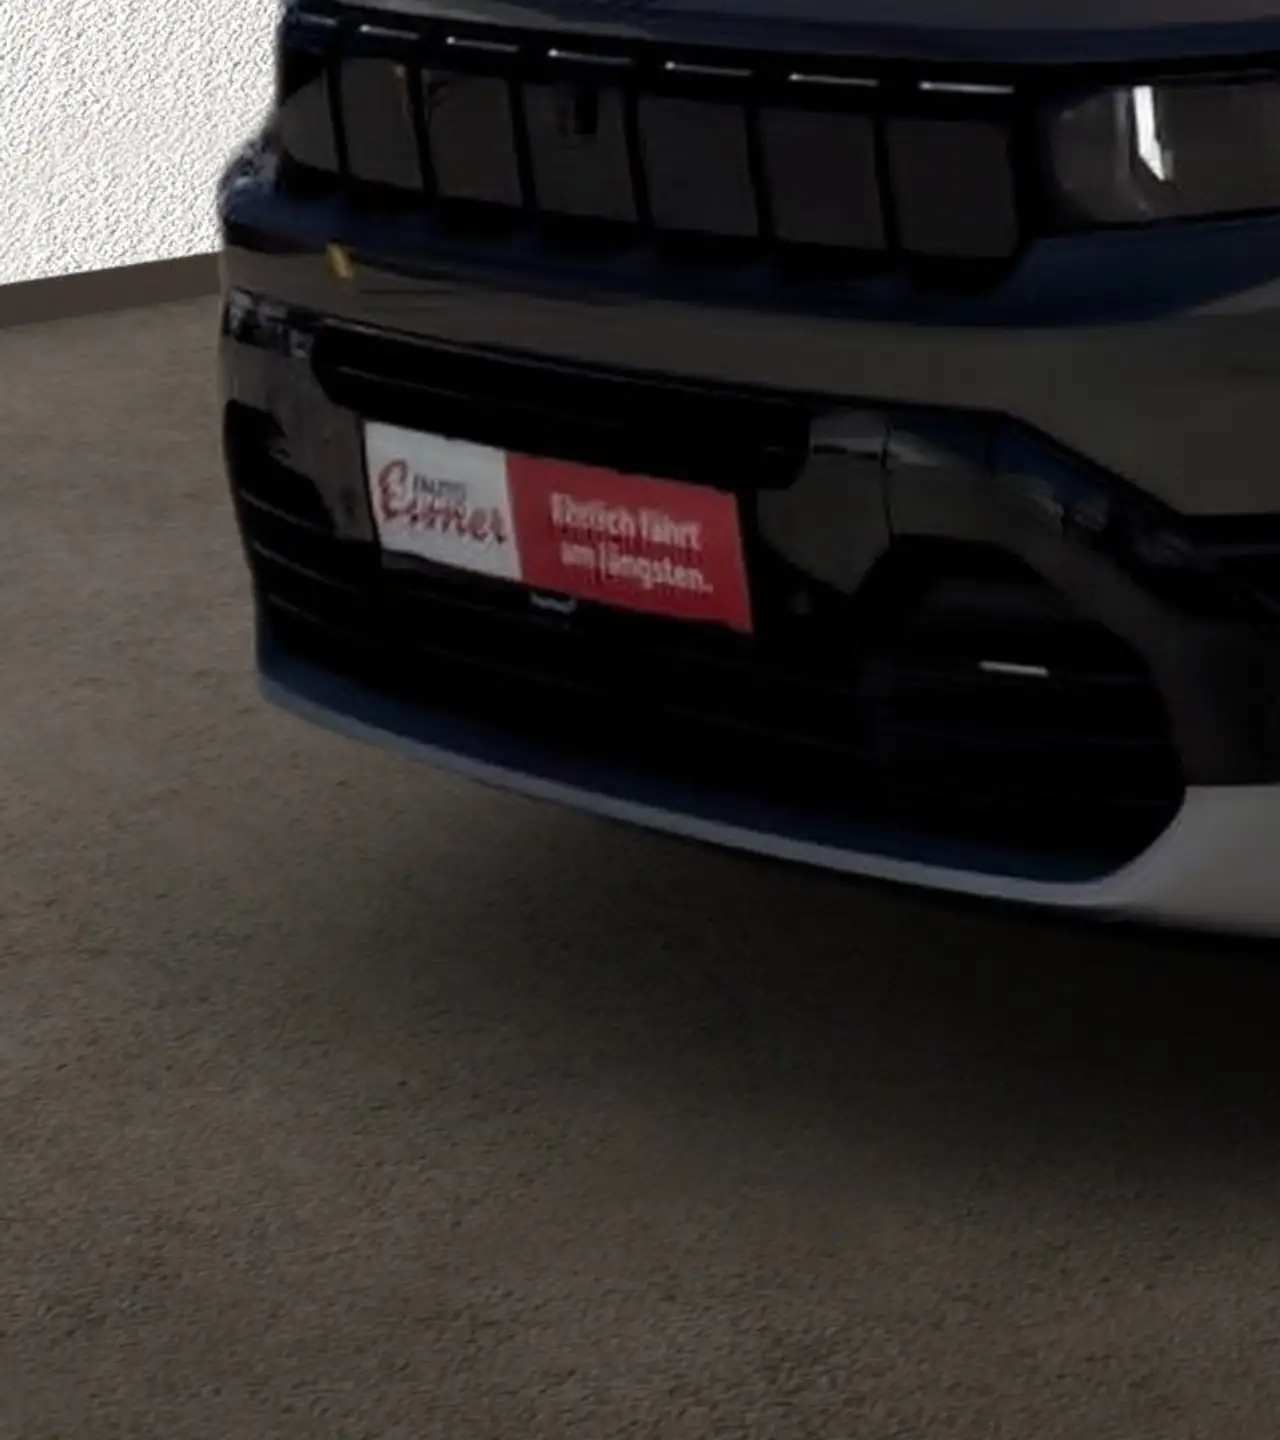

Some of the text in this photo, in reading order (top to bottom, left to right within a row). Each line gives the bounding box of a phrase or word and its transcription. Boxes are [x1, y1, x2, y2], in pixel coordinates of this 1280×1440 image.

[550, 491, 703, 550] Ehrlich fährt
[560, 541, 714, 594] am längsten.
